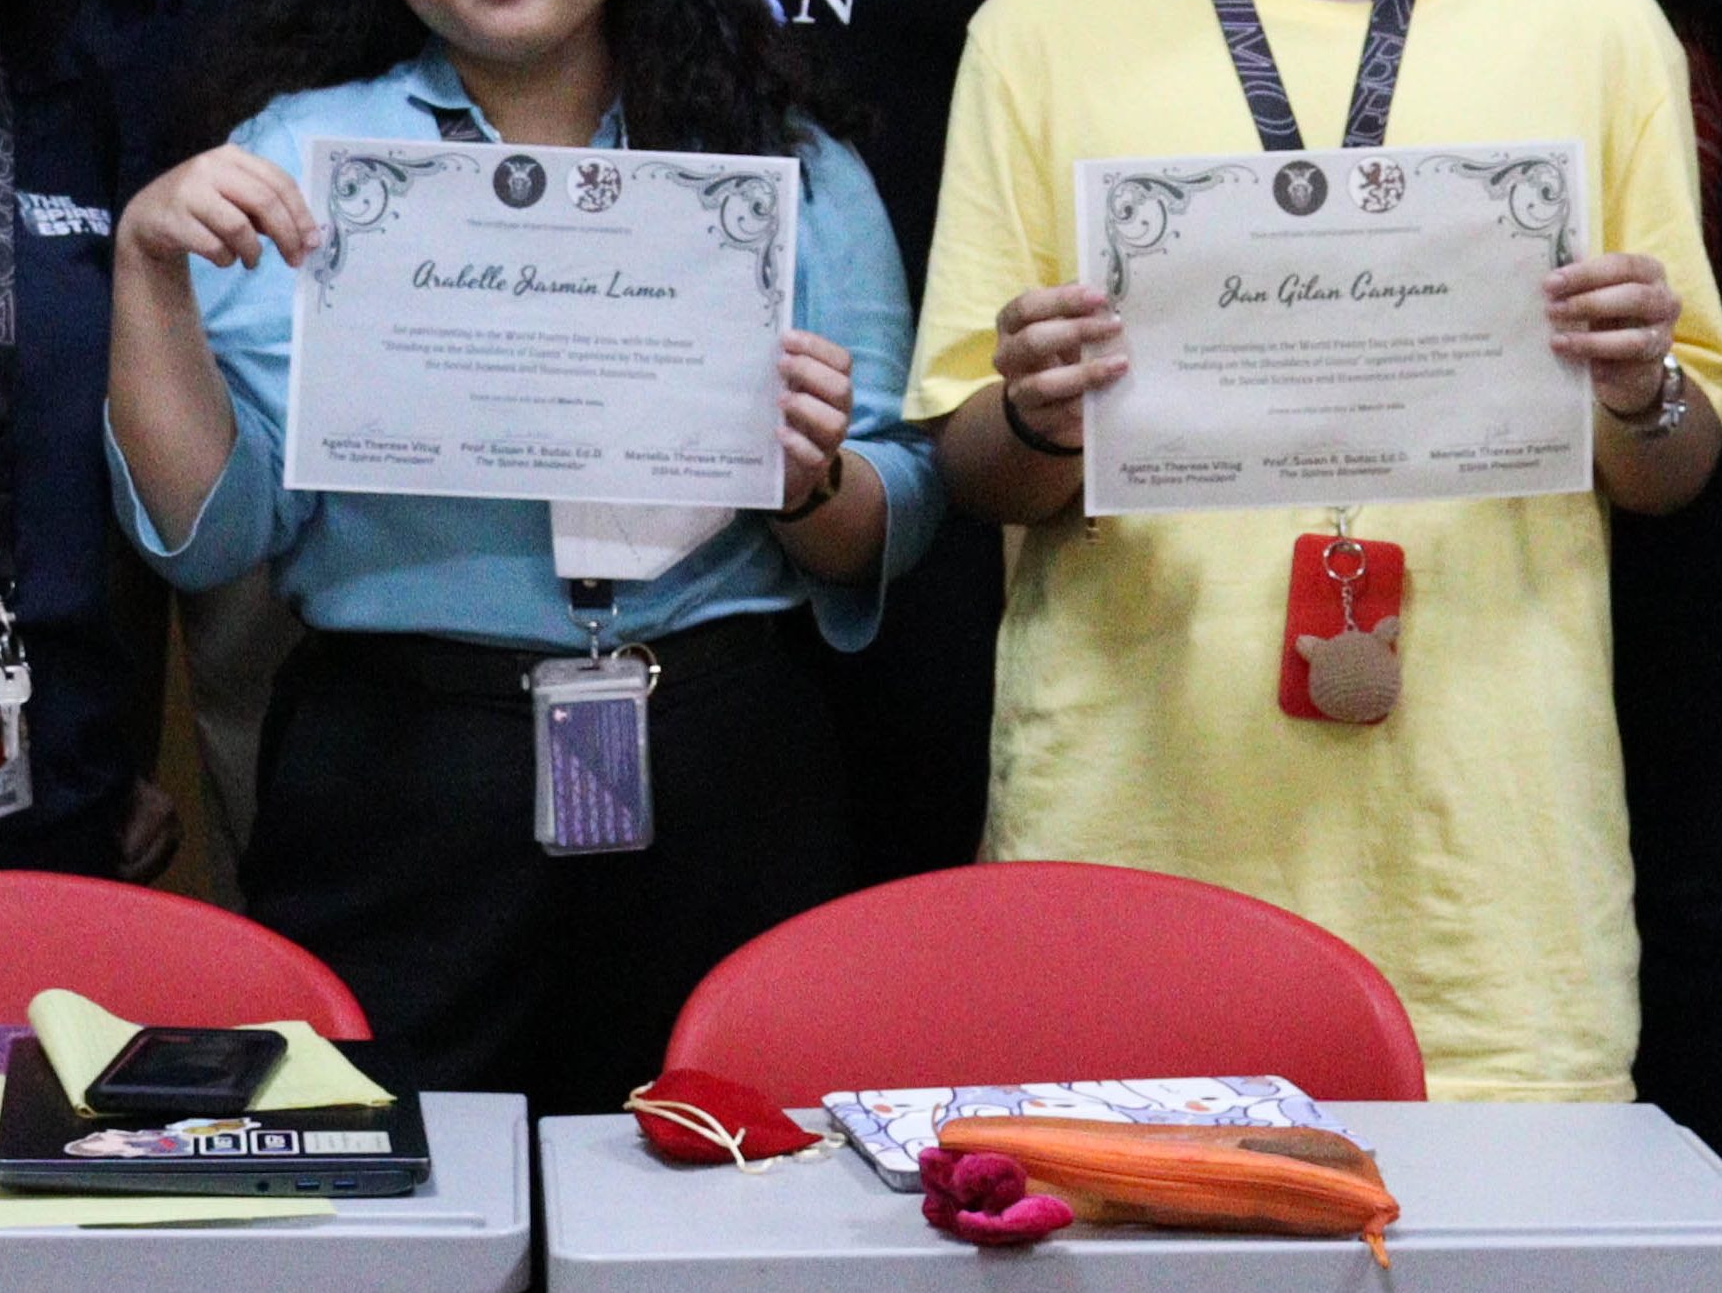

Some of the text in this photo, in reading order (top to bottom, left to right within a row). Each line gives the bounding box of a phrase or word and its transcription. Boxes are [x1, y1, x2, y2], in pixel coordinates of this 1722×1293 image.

[413, 260, 507, 291] Arabelle
[513, 265, 598, 296] Jasmin
[1218, 275, 1268, 308] Jan
